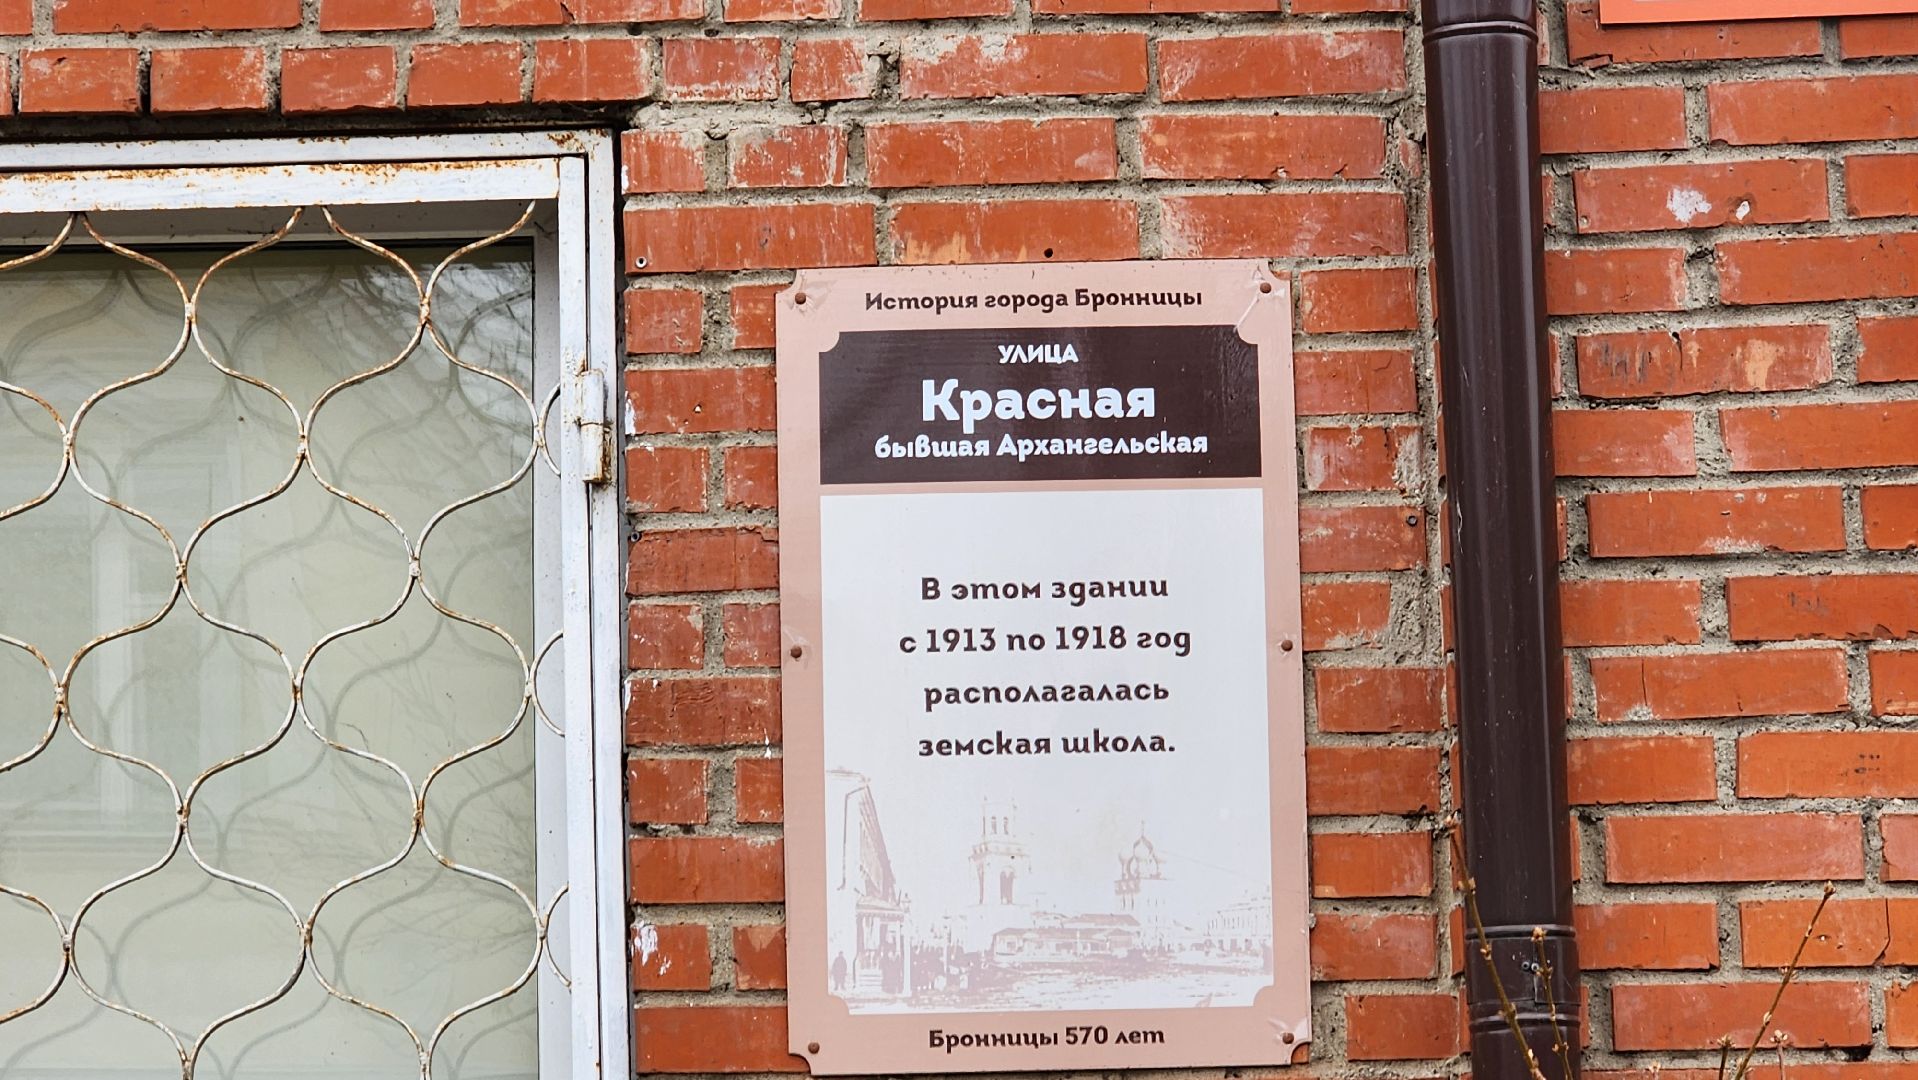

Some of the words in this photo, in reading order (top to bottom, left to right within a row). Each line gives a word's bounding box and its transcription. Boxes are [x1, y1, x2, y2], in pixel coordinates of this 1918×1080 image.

[865, 291, 978, 315] История
[984, 293, 1069, 315] города
[1074, 288, 1202, 313] Бронницы
[921, 378, 1156, 434] Красная
[874, 434, 990, 459] бывшая
[995, 430, 1208, 462] Архангельская
[921, 577, 941, 600] В
[951, 582, 1041, 600] этом
[1051, 580, 1169, 607] здании
[899, 636, 917, 654] с
[926, 627, 996, 653] 1913
[1006, 632, 1046, 651] по
[1055, 625, 1127, 650] 1918
[1136, 631, 1191, 658] год
[923, 683, 1170, 713] располагалась
[918, 730, 1051, 757] земская
[1061, 728, 1176, 754] школа.
[928, 1028, 1059, 1054] Бронницы
[1065, 1025, 1109, 1046] 570
[1114, 1030, 1165, 1045] лет
